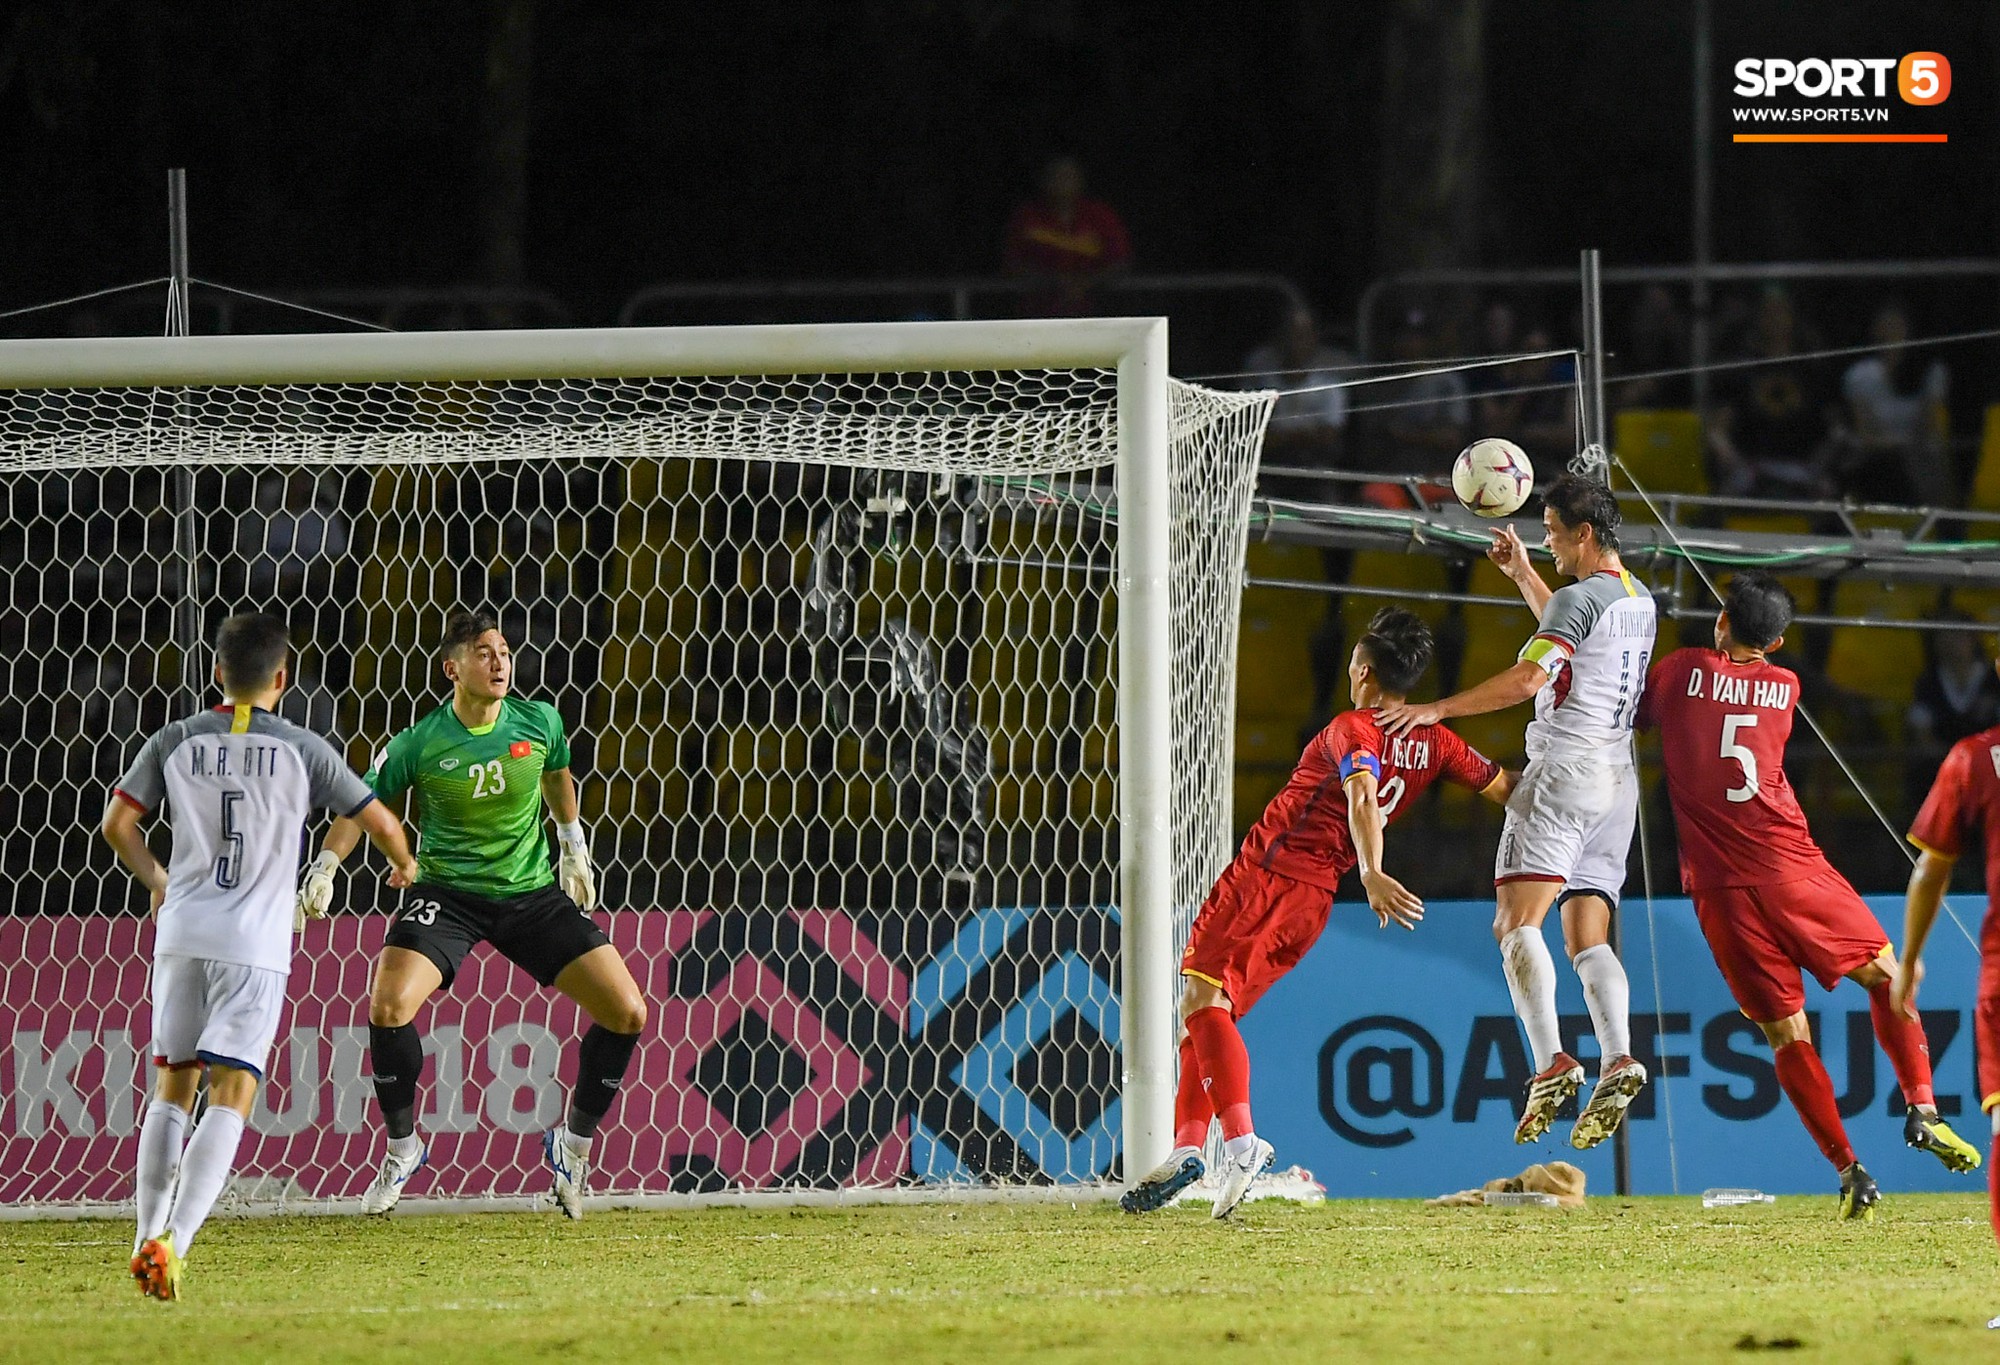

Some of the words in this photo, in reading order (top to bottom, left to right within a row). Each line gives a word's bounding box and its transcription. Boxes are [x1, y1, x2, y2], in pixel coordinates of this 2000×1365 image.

[1687, 667, 1704, 699] D.
[1712, 671, 1748, 706] VAN
[1752, 680, 1790, 711] HAU
[469, 760, 506, 799] 23
[1720, 714, 1759, 803] 5
[214, 790, 244, 890] 5
[401, 898, 441, 926] 23
